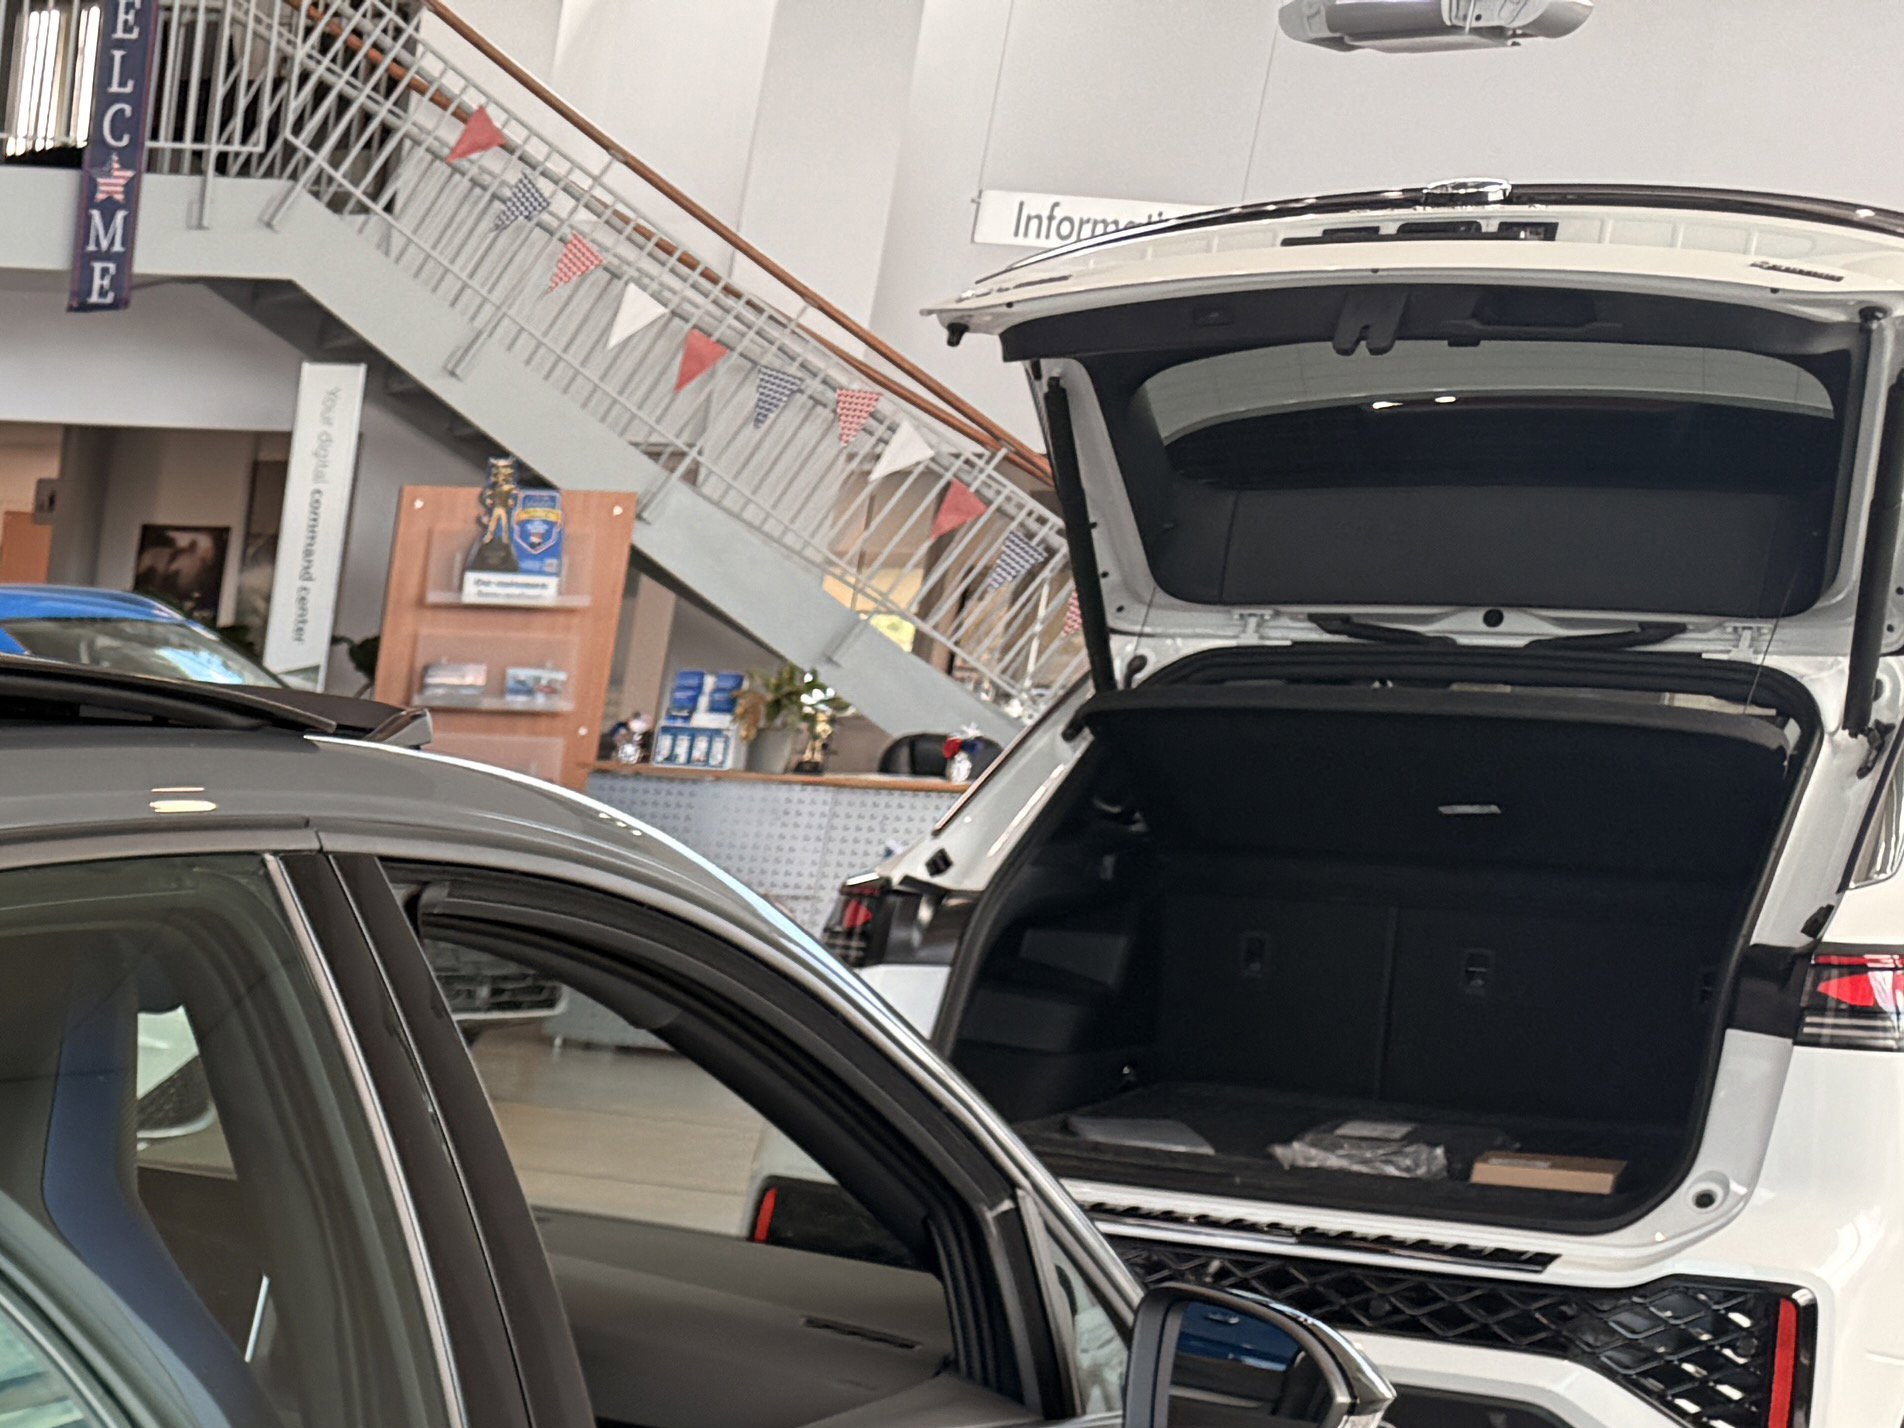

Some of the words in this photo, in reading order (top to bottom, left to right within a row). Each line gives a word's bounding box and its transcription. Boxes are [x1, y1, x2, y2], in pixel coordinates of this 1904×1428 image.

[1013, 200, 1164, 241] Inform
[299, 487, 324, 582] command
[293, 586, 310, 645] center
